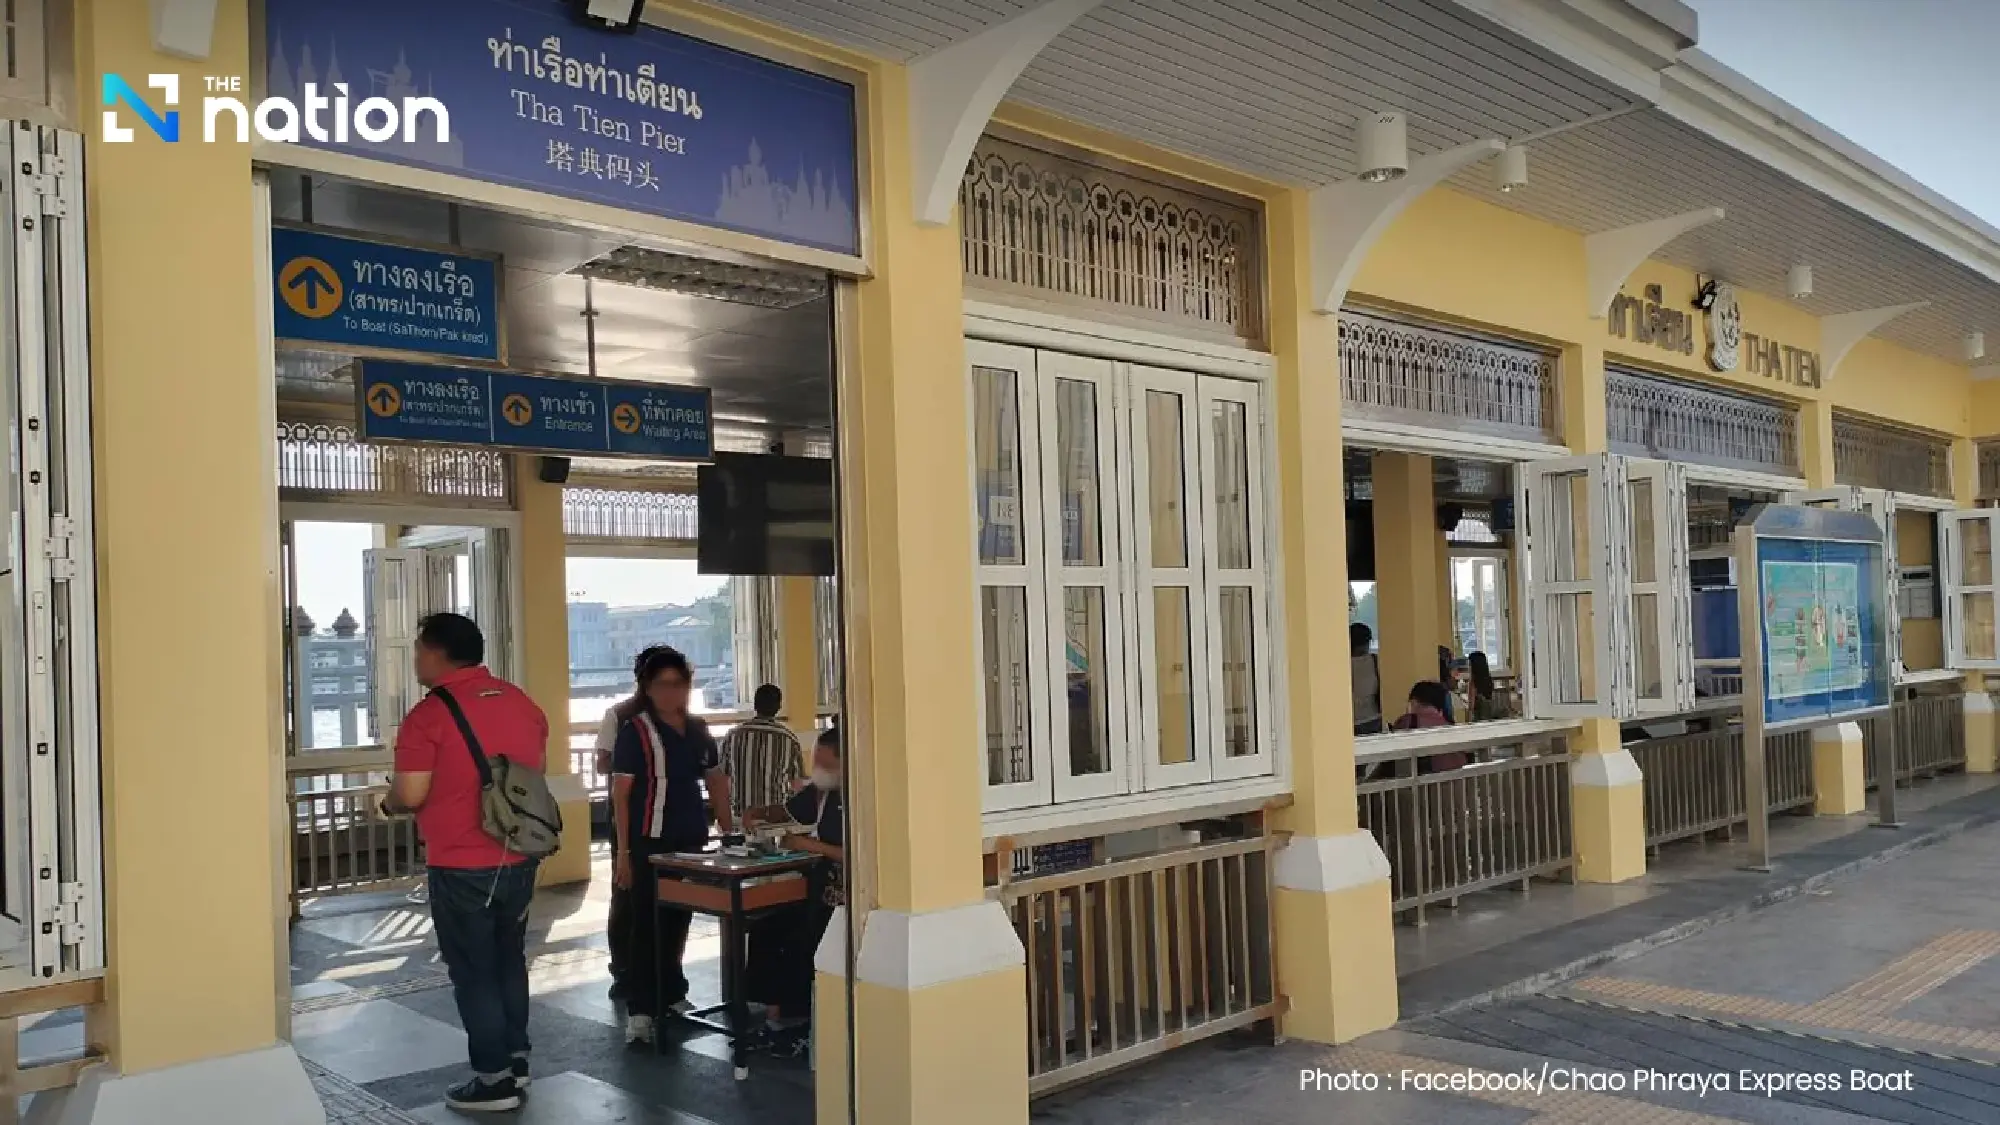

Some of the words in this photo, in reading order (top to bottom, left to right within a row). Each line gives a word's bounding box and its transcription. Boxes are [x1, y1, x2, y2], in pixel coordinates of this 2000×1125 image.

[487, 28, 703, 120] ท่าเรือท่าเตียน
[511, 88, 565, 127] Tha
[573, 104, 632, 143] Tien
[640, 120, 686, 155] Pier
[546, 139, 660, 192] 塔典码头
[352, 259, 475, 298] ทางลงเรือ
[343, 315, 358, 330] To
[361, 318, 387, 333] Boat
[404, 378, 480, 400] ทางลงเรือ
[540, 390, 596, 415] ทางเข้า
[544, 416, 593, 432] Entrance
